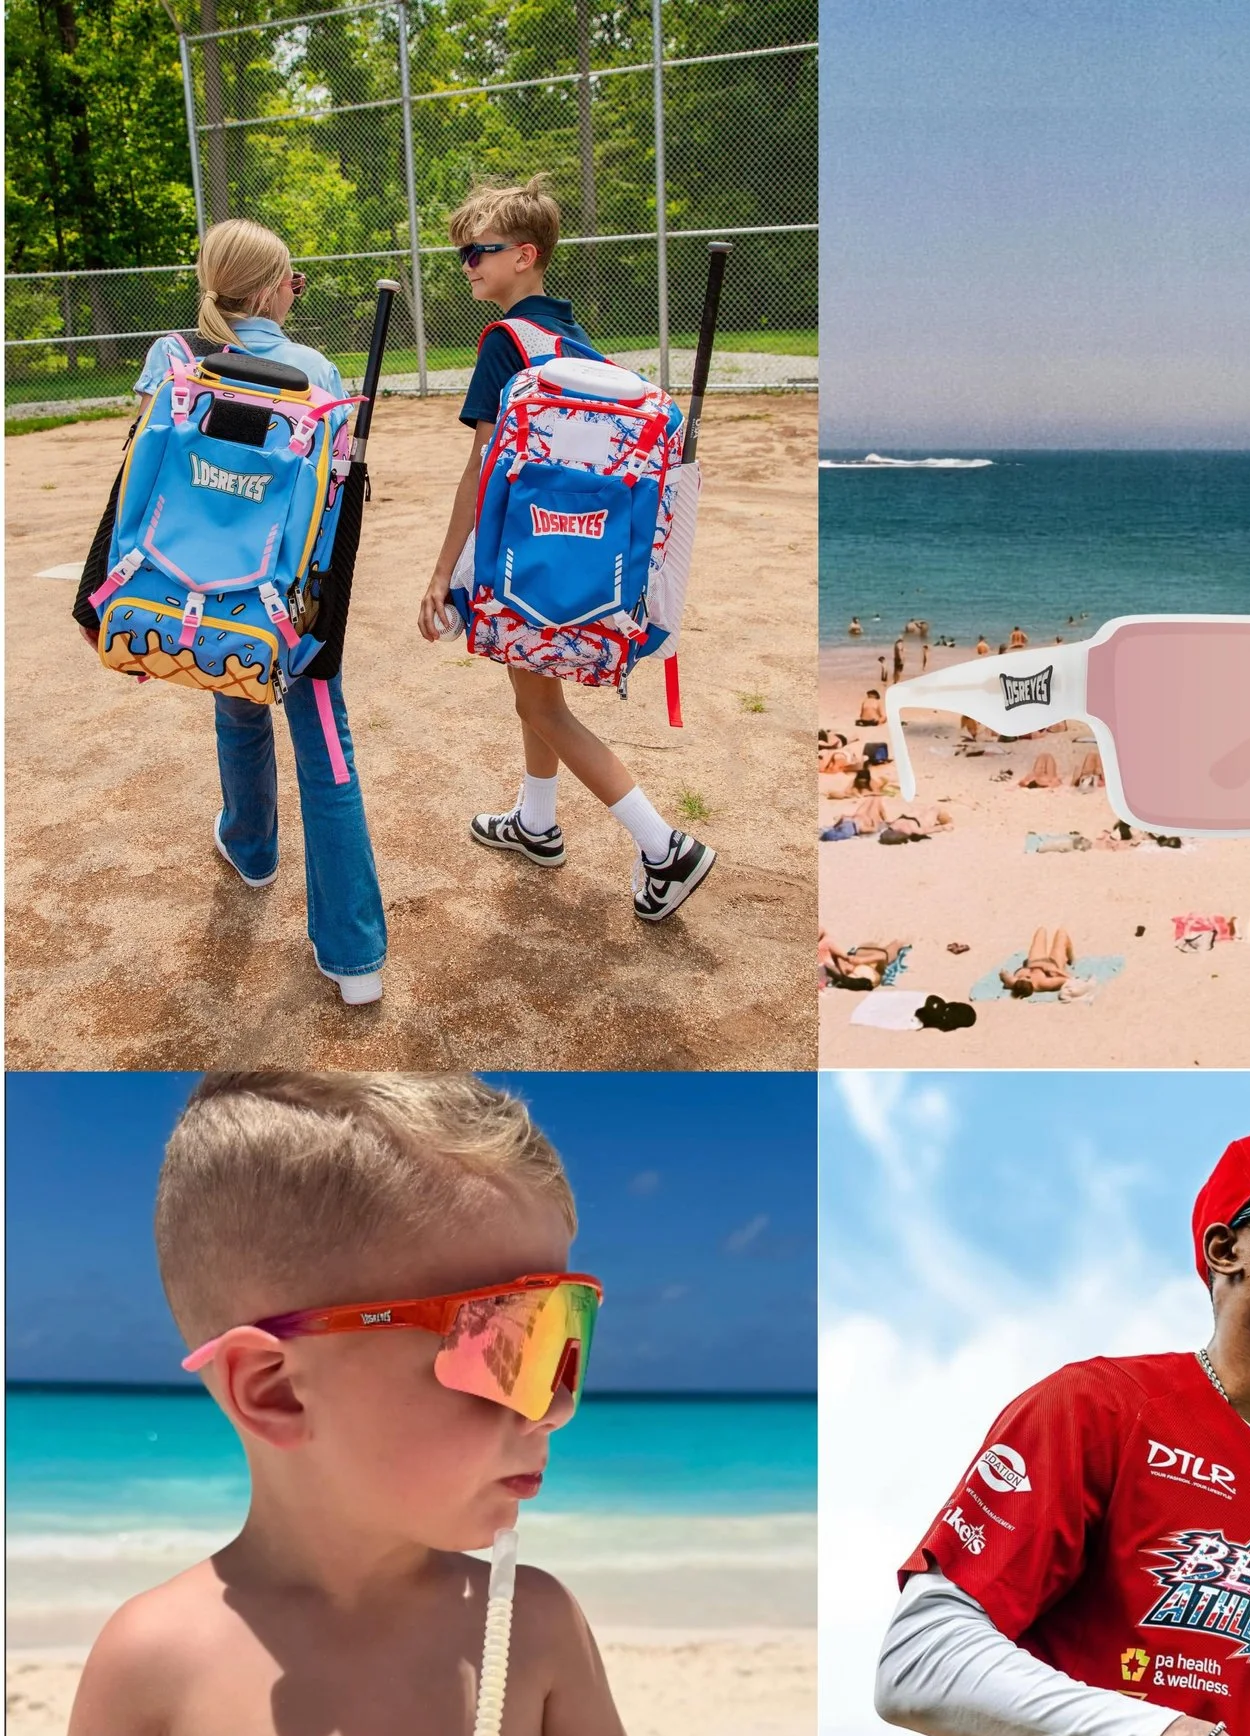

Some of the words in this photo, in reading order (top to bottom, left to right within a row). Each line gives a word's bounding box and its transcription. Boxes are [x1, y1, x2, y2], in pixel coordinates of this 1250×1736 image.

[190, 452, 274, 504] LOSREYES
[530, 504, 609, 540] LOSREYES
[999, 665, 1053, 711] LOSREYES
[1147, 1439, 1237, 1495] DTLR
[965, 1486, 984, 1508] WEALTH
[982, 1504, 1016, 1533] MANAGEMENT
[1153, 1670, 1166, 1686] &
[1155, 1654, 1174, 1669] pa
[1177, 1653, 1222, 1676] health
